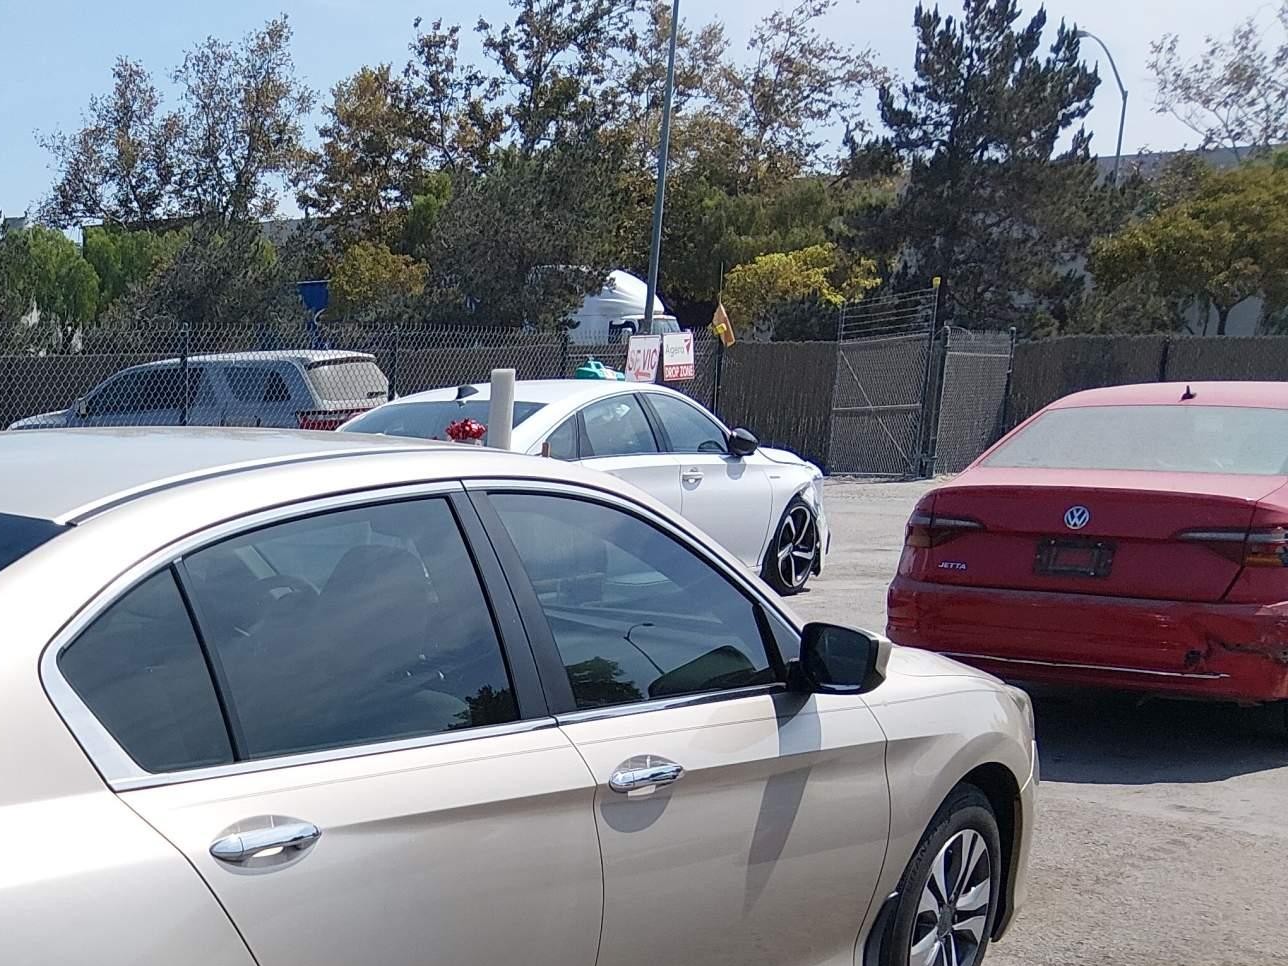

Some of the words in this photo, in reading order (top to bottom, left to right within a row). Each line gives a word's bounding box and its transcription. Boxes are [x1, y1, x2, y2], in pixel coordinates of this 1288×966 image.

[665, 344, 684, 357] Agero
[665, 366, 679, 378] DROP
[679, 365, 695, 377] ZONE
[938, 562, 966, 570] JETTA
